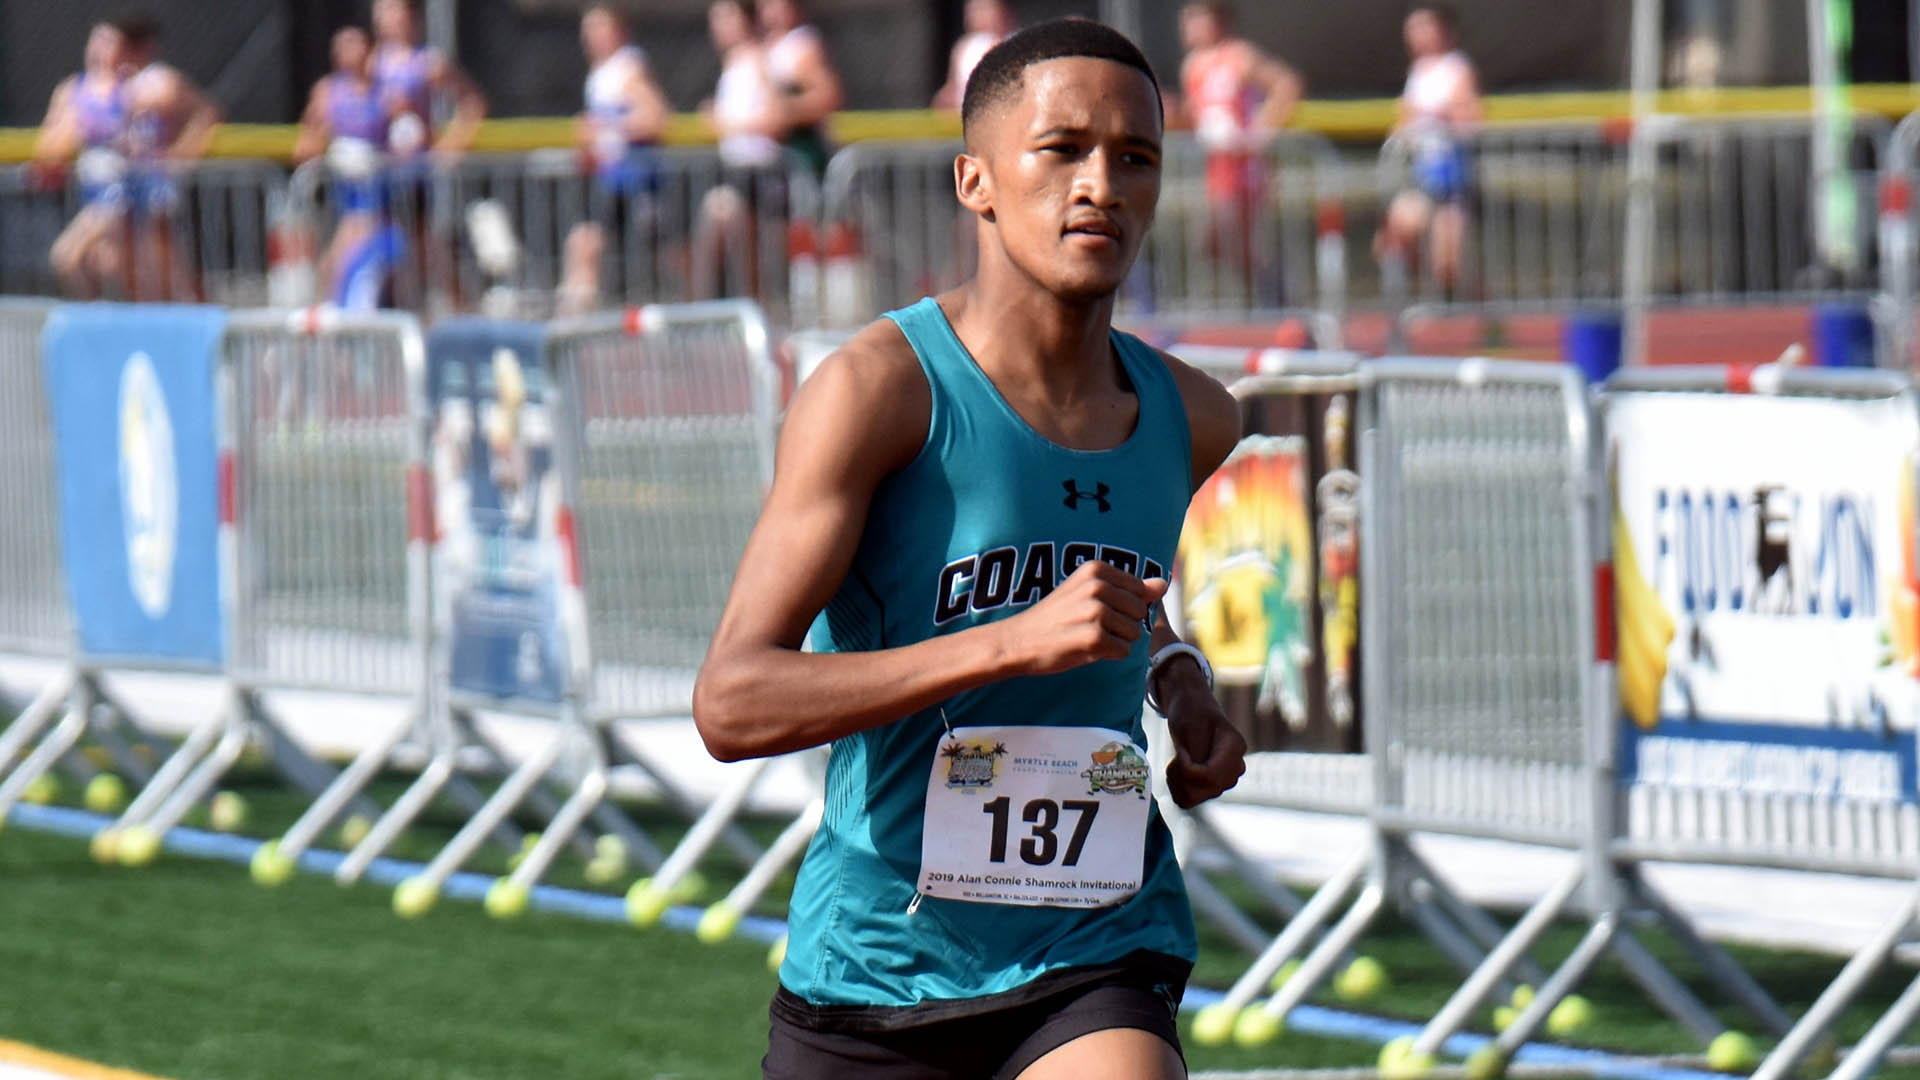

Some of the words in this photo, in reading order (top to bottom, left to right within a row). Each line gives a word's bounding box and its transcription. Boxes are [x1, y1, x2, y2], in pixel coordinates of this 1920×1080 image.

[1013, 757, 1048, 767] MYRTLE
[1051, 759, 1078, 769] BEACH
[983, 796, 1100, 866] 137
[927, 872, 954, 883] 2019
[957, 873, 981, 885] Alan
[984, 875, 1021, 887] Connie
[1025, 877, 1077, 890] Shamrock
[1080, 879, 1136, 892] Invitational
